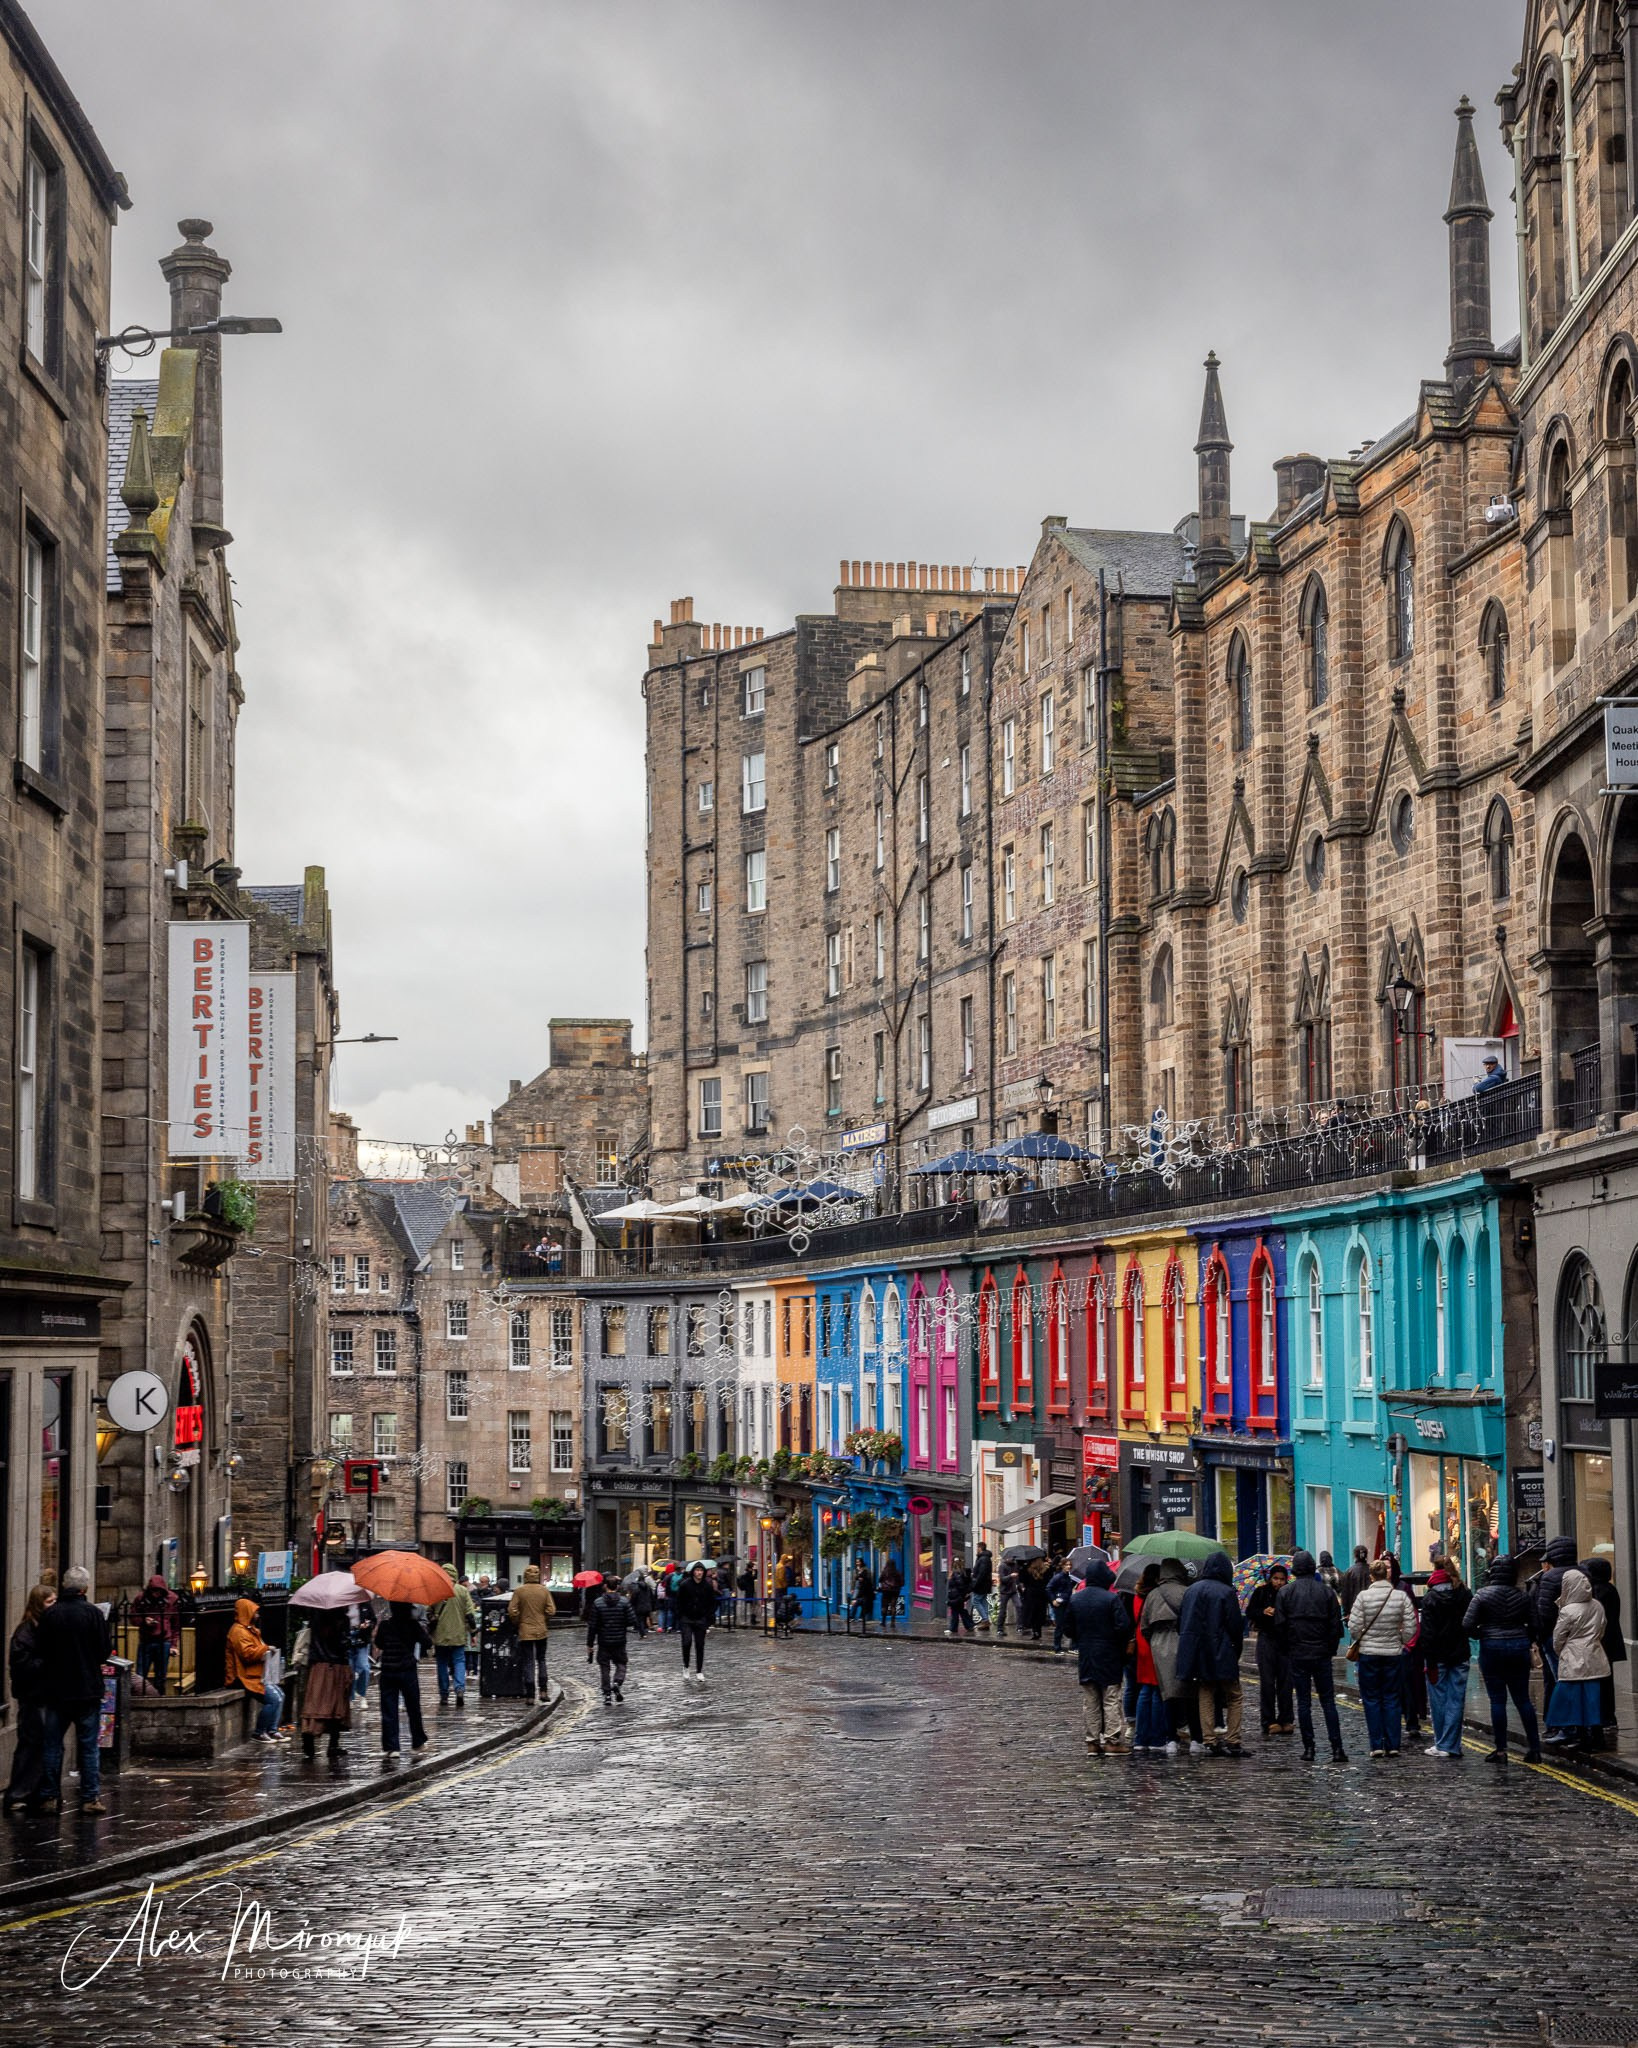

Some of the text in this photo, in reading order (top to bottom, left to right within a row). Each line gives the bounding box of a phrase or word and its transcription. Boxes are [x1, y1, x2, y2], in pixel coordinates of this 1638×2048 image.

[1612, 725, 1638, 735] Quak
[1612, 742, 1638, 750] Meeti
[1616, 758, 1638, 766] Hous
[192, 938, 214, 1138] BERTIES
[248, 987, 264, 1165] BERTIES
[1603, 1390, 1638, 1399] Walker S
[135, 1387, 158, 1416] K
[1133, 1448, 1185, 1464] THE WHISKY SHOP
[613, 1481, 639, 1490] Walker
